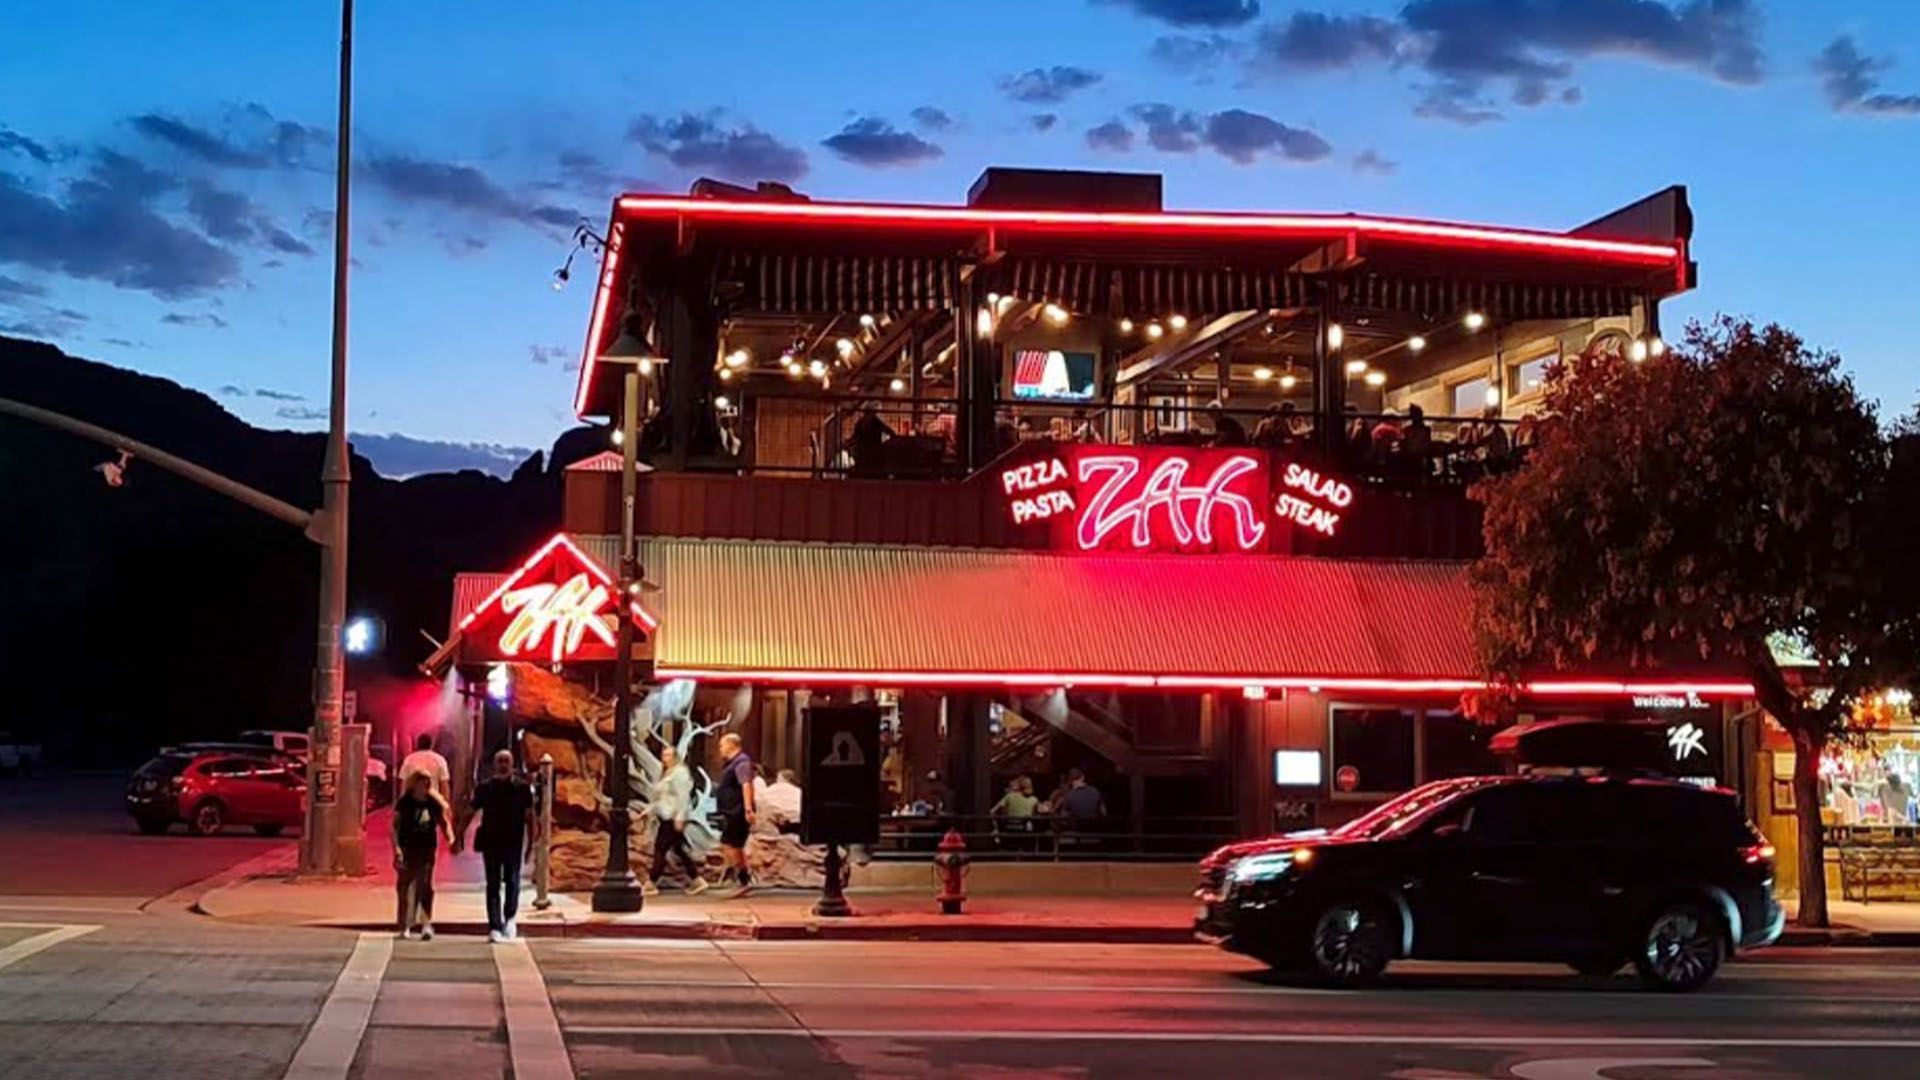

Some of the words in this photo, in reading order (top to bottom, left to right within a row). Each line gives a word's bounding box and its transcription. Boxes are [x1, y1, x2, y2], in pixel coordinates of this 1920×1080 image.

[1002, 458, 1068, 495] PIZZA
[1283, 463, 1352, 507] SALAD
[1011, 490, 1076, 524] PASTA
[1275, 493, 1340, 535] STEAK
